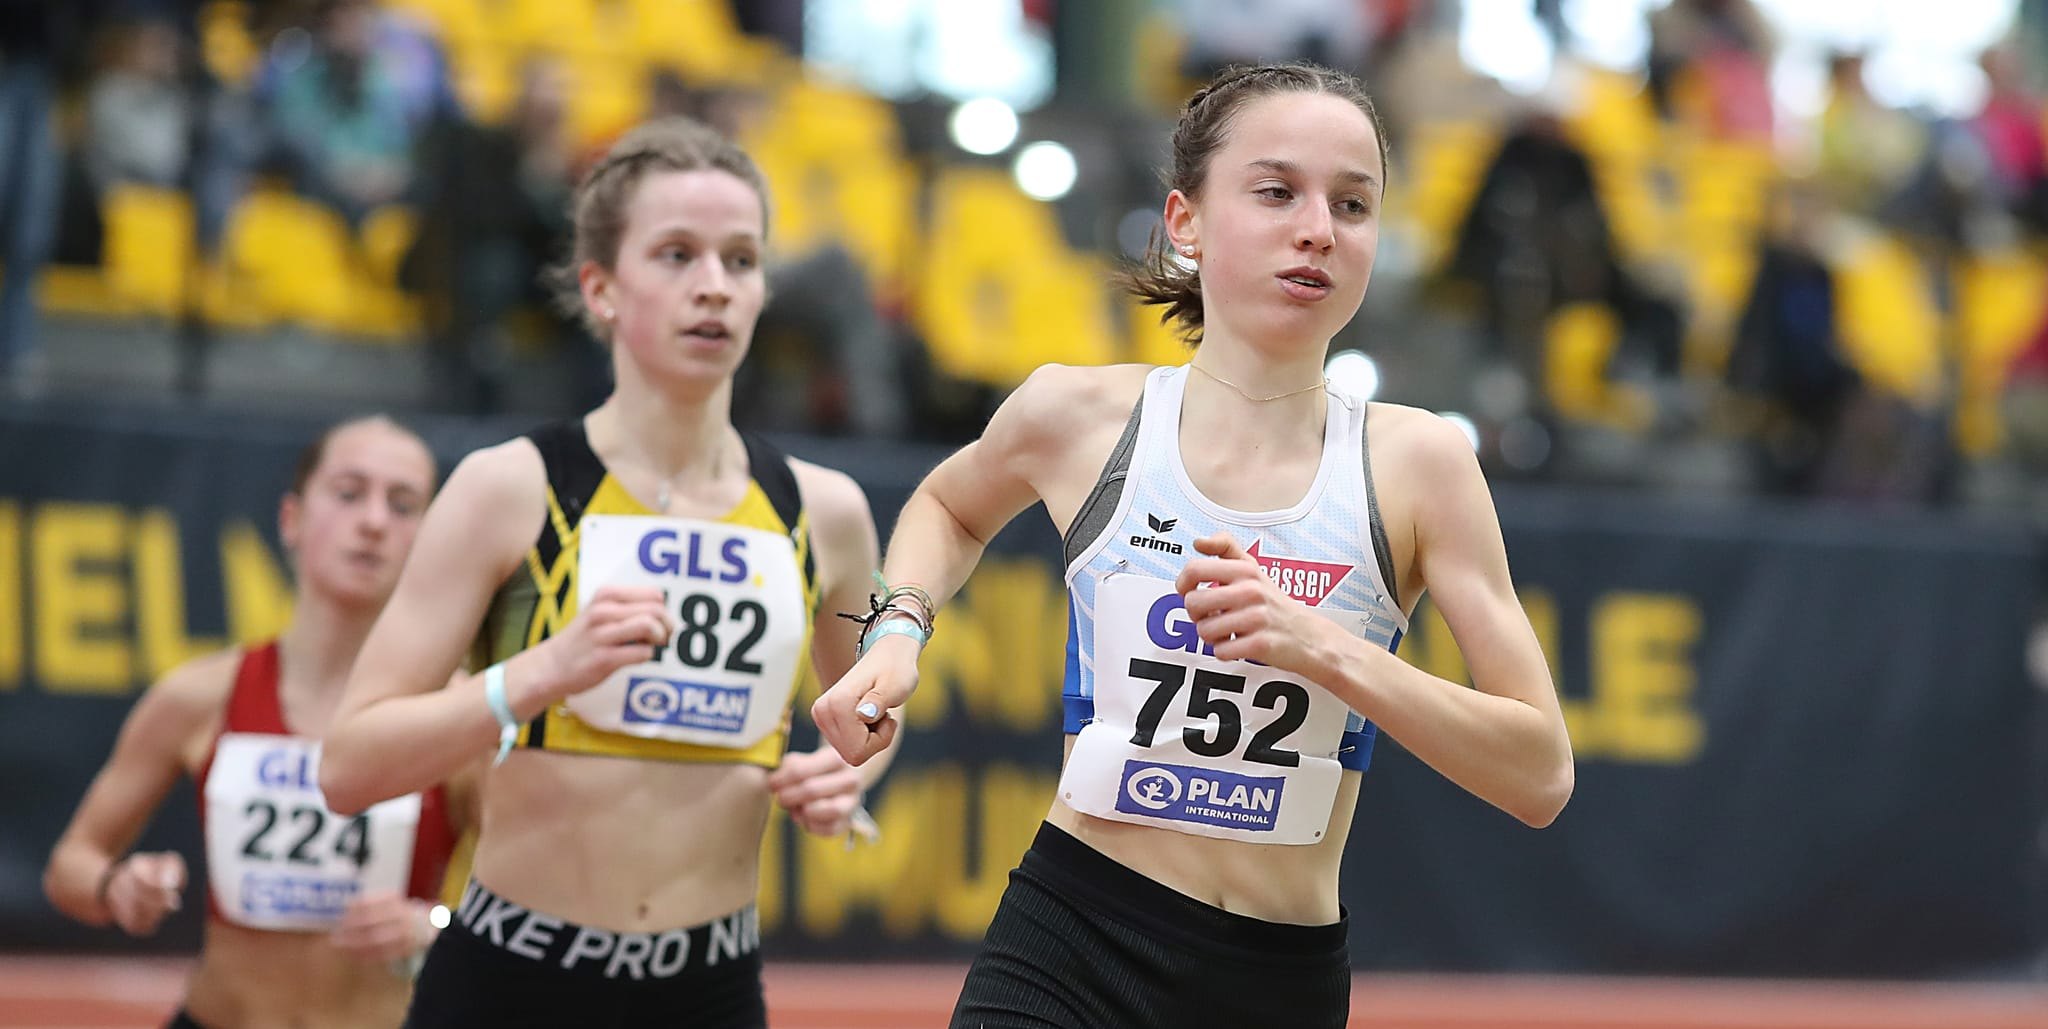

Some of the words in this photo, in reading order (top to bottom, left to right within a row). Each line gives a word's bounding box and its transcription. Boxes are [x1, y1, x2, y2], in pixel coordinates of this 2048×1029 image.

[1130, 534, 1183, 556] erima
[652, 592, 768, 675] 82
[680, 688, 748, 717] PLAN
[1128, 657, 1310, 768] 752
[1185, 805, 1270, 825] INTERNATIONAL
[1187, 777, 1276, 813] PLAN
[241, 800, 371, 868] 224
[561, 928, 692, 981] PRO
